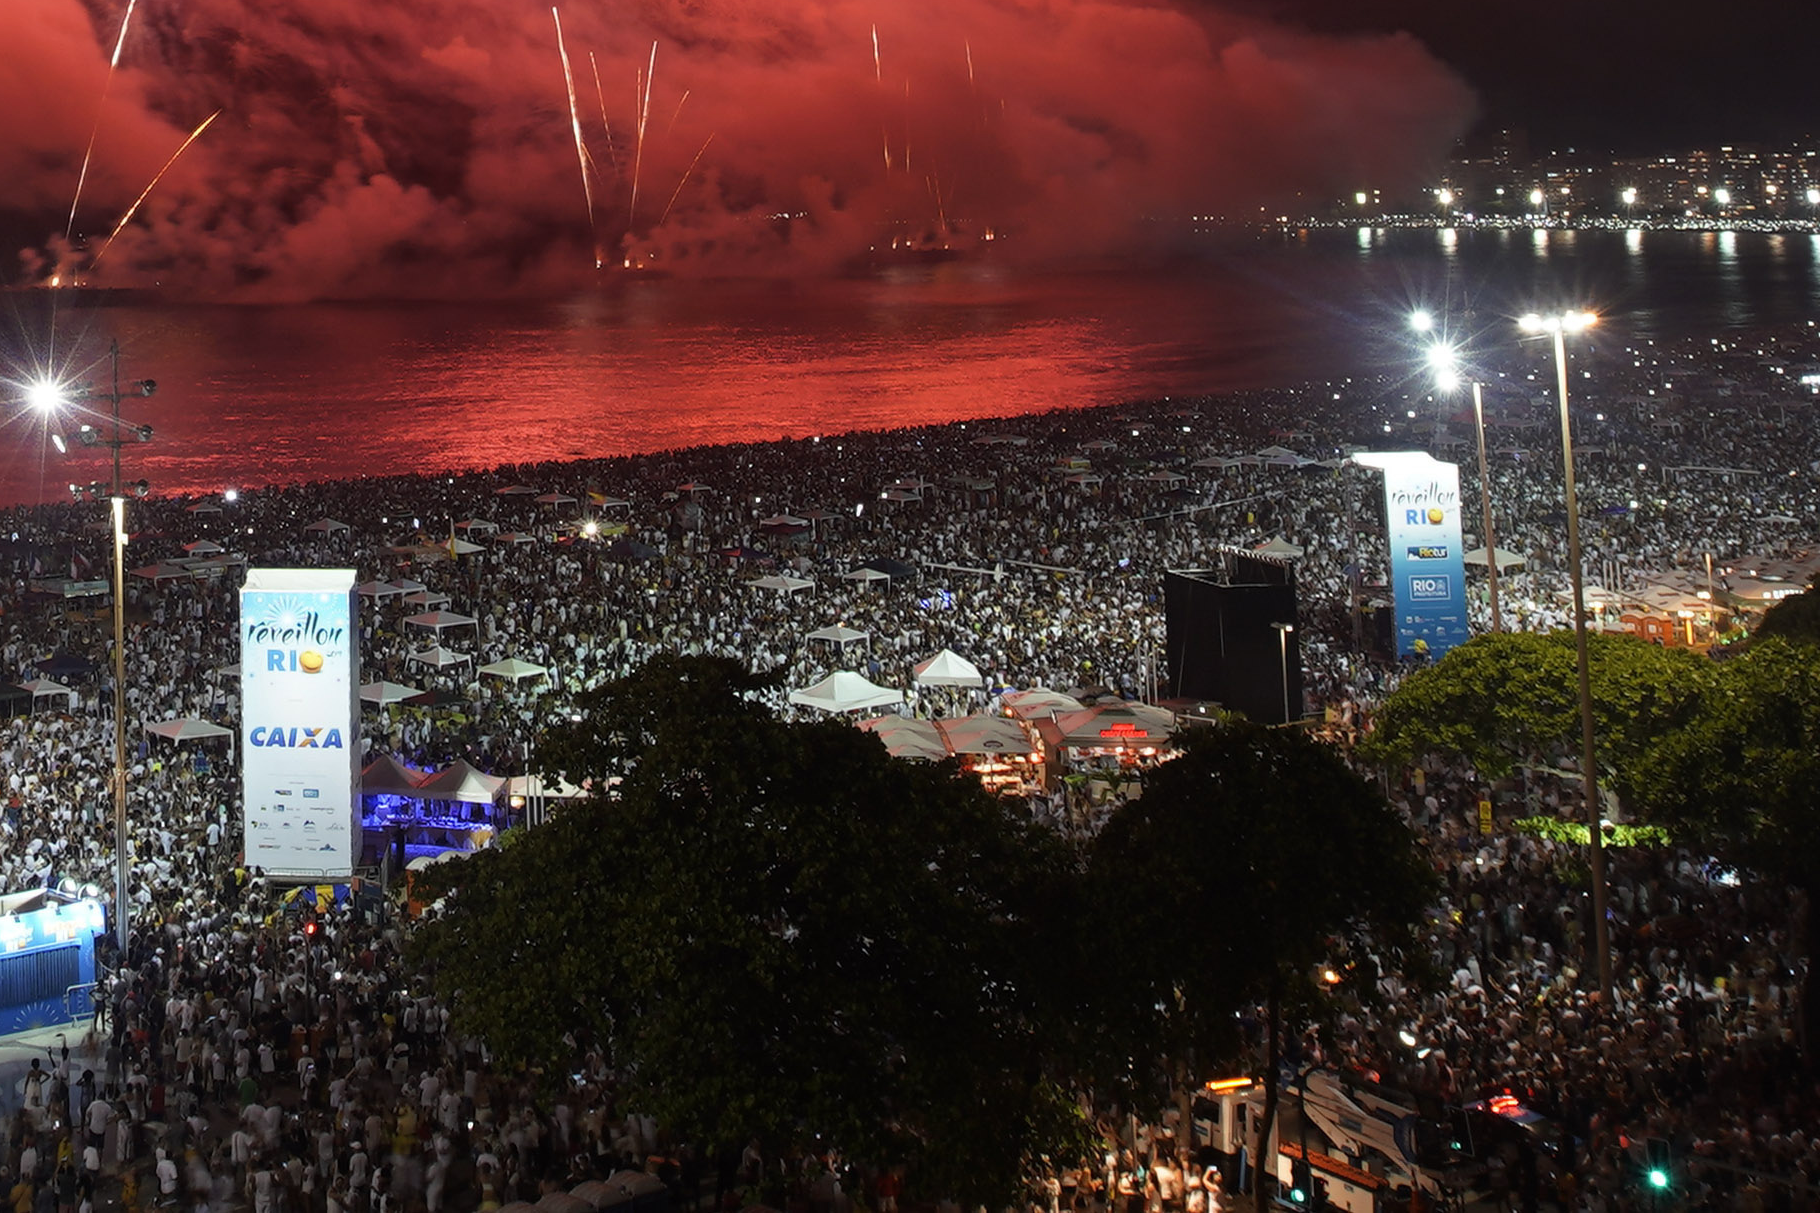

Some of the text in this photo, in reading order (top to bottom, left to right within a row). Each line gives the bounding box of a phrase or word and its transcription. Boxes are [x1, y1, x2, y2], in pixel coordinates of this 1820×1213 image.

[1405, 508, 1444, 526] RIO
[1412, 579, 1436, 592] RIO
[267, 649, 324, 674] RIO
[249, 726, 344, 749] CAIXA
